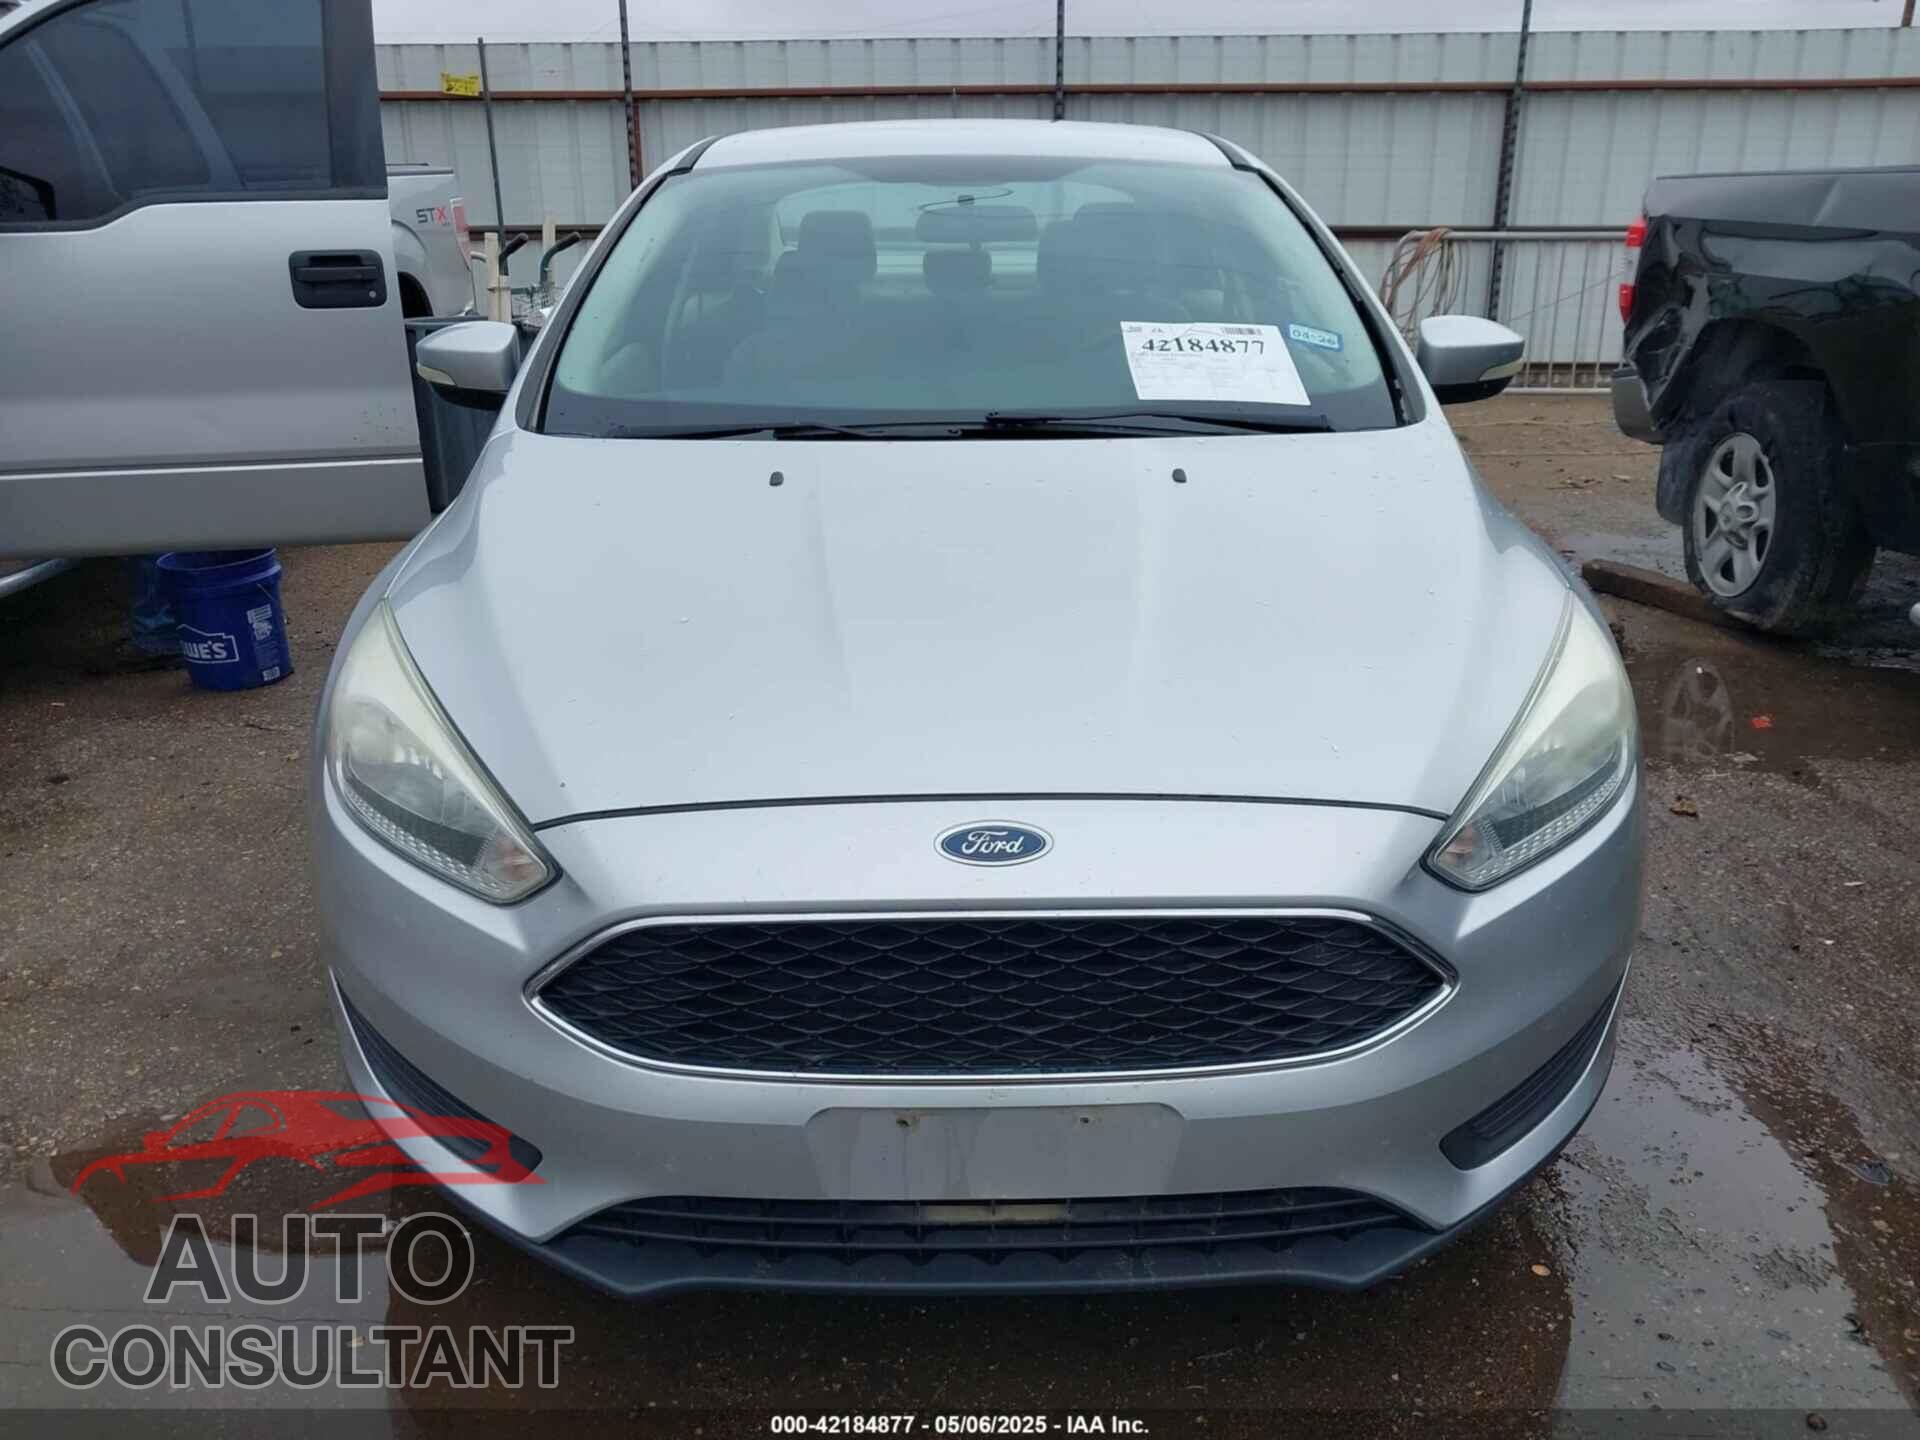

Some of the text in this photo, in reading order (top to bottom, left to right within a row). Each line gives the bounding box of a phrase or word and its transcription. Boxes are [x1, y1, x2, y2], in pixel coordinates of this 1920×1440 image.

[415, 207, 447, 224] STX
[1142, 337, 1264, 355] 42184877
[181, 640, 228, 659] WE'S
[961, 830, 1025, 854] Ford
